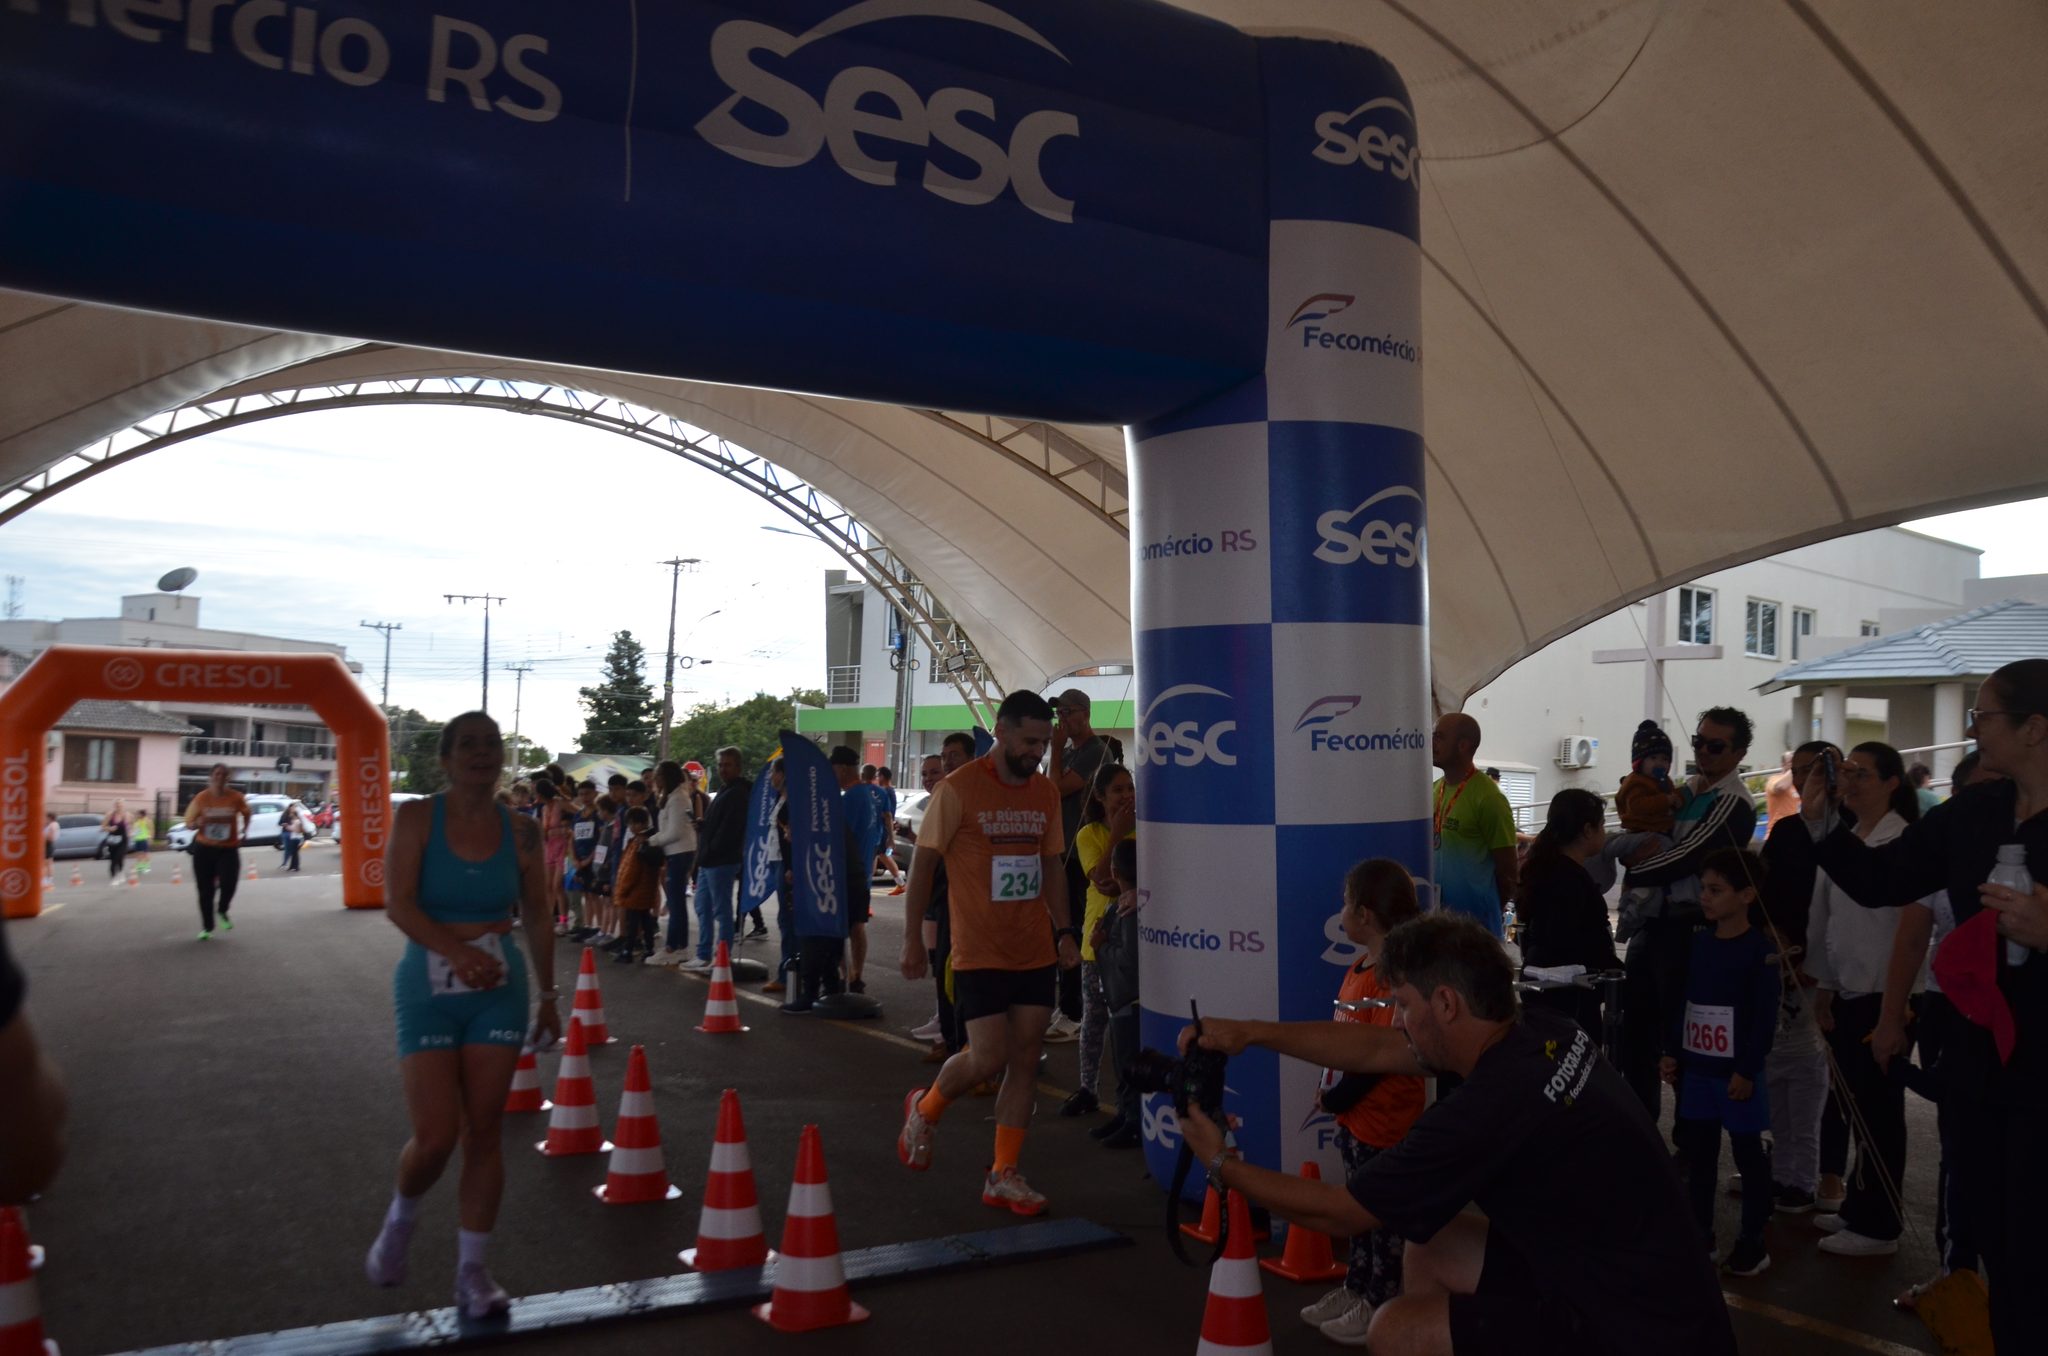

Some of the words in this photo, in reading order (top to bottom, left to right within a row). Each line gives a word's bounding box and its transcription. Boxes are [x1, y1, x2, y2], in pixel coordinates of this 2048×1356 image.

[426, 15, 563, 122] RS
[694, 20, 1080, 223] Sesc
[1303, 326, 1415, 362] Fecomércio
[1221, 529, 1257, 552] RS
[155, 664, 292, 689] CRESOL
[1311, 728, 1425, 752] Fecomércio
[6, 749, 29, 859] CRESOL
[359, 749, 384, 850] CRESOL
[995, 806, 1047, 823] RÚSTICA
[982, 822, 1044, 836] REGIONAL
[814, 842, 838, 915] Sesc
[1000, 872, 1039, 897] 234
[1229, 930, 1265, 952] RS
[1686, 1020, 1728, 1052] 1266
